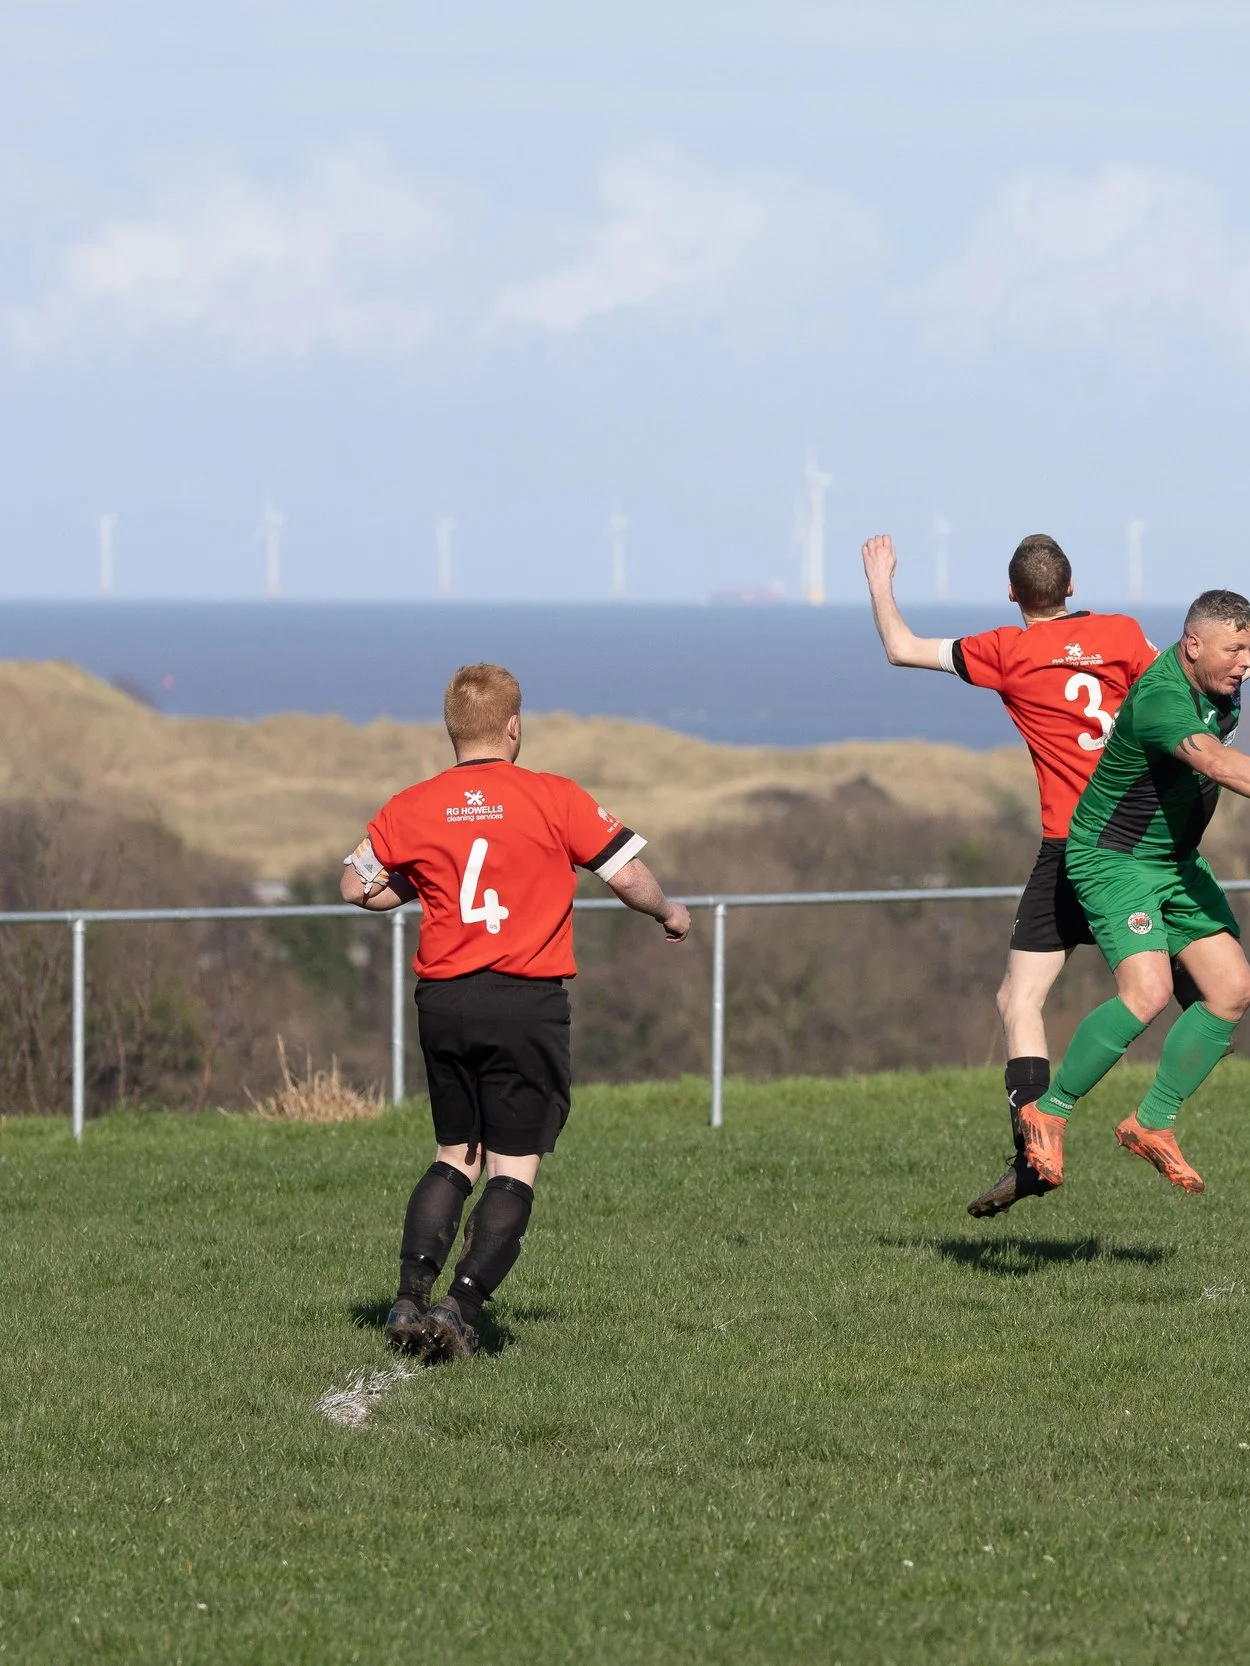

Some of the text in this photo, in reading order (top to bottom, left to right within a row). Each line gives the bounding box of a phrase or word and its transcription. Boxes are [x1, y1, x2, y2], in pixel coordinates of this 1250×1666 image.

[1065, 672, 1114, 751] 3
[446, 805, 503, 816] RG HOWELLS
[446, 813, 504, 823] cleaning services
[460, 838, 509, 934] 4
